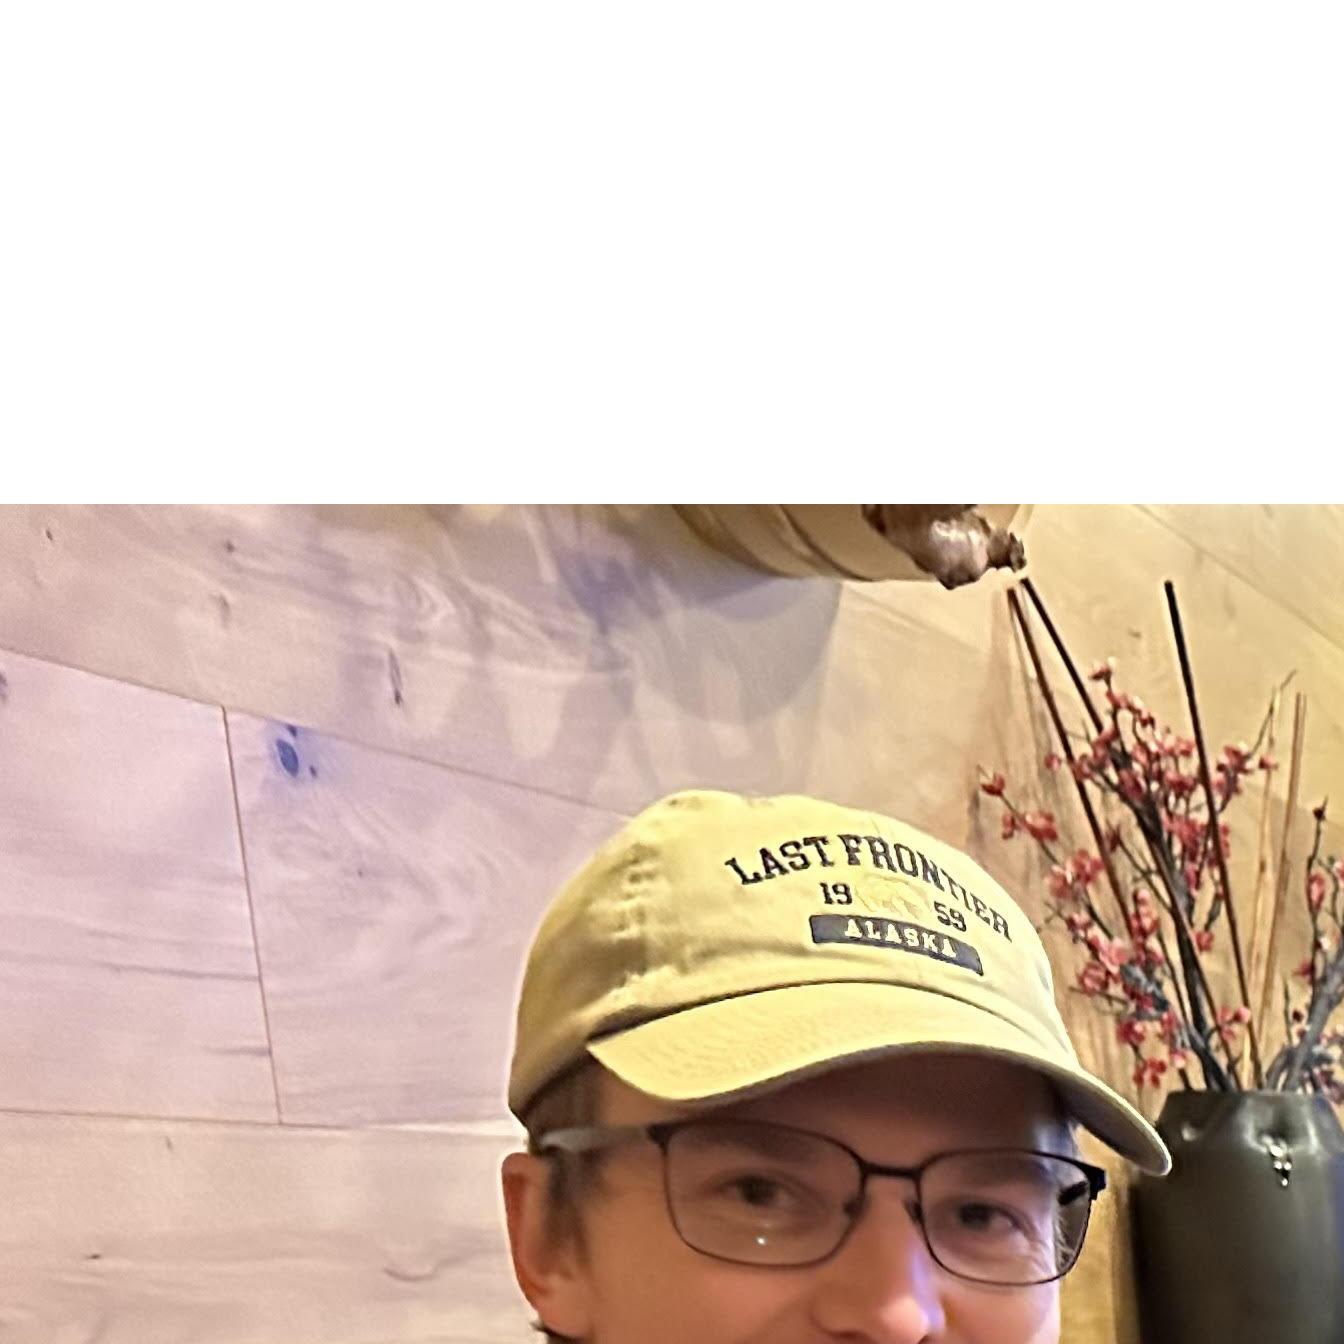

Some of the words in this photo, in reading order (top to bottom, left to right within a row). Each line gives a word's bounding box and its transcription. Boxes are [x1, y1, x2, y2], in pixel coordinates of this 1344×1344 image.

[725, 836, 835, 885] LAST
[838, 834, 1012, 943] FRONTIER
[820, 882, 853, 905] 19
[933, 900, 967, 932] 59
[845, 918, 957, 958] ALASKA
